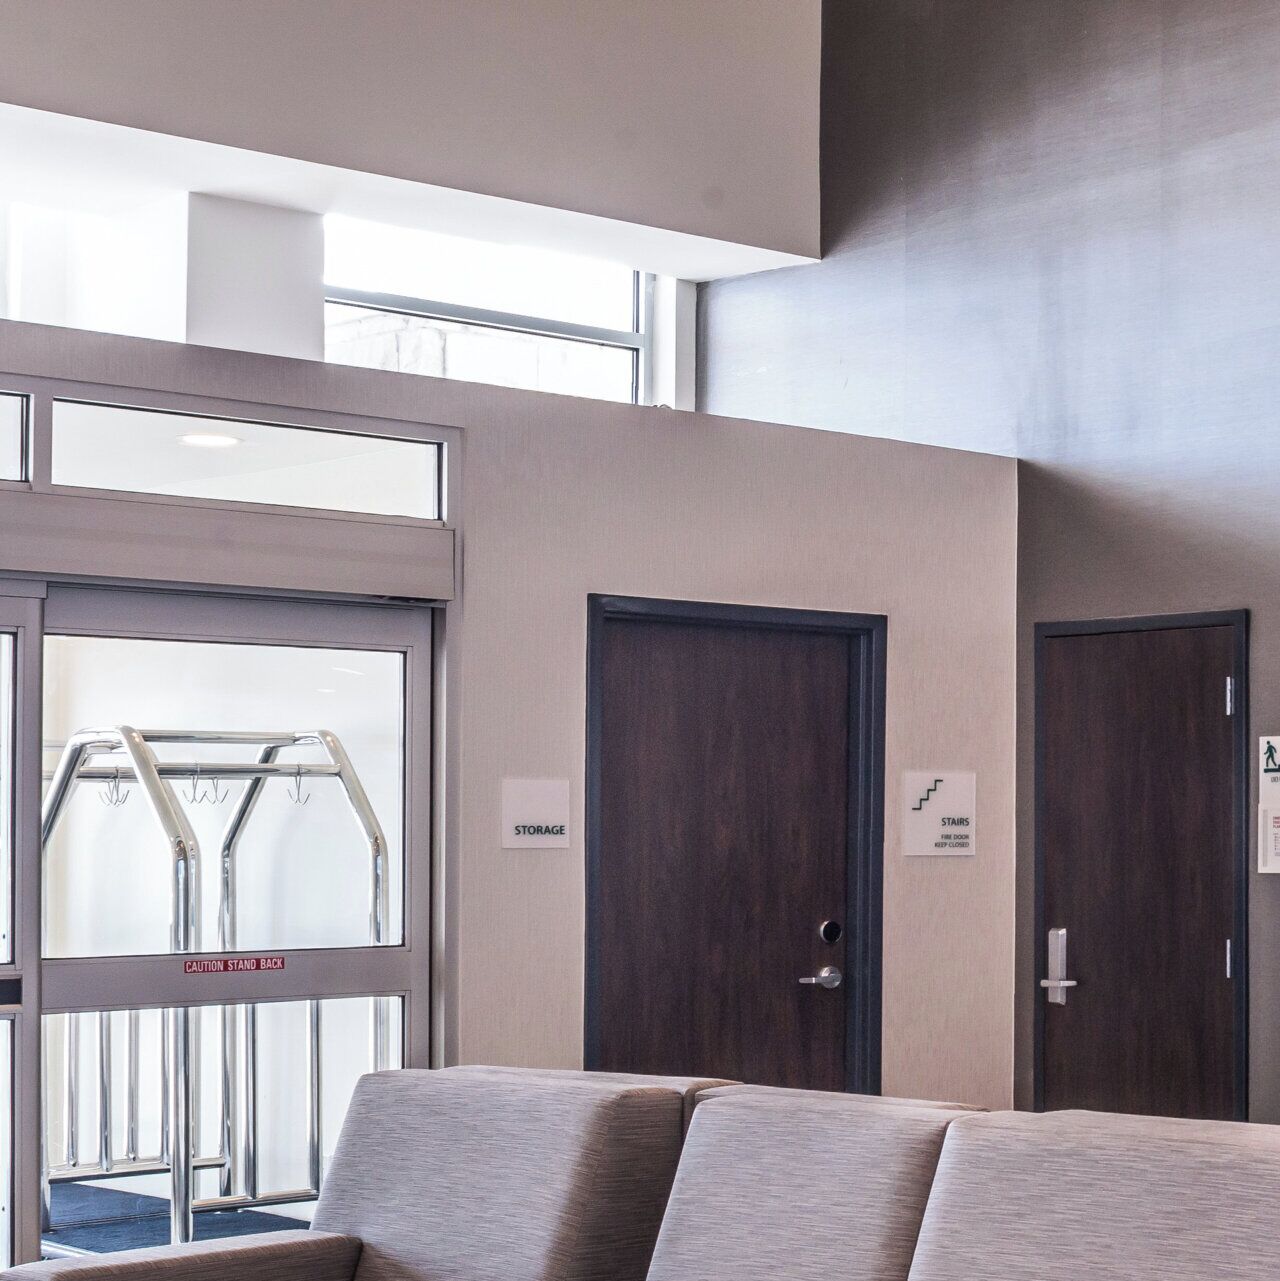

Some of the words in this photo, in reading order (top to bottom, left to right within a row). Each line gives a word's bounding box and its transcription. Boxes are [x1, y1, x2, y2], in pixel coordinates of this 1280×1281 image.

[941, 817, 970, 826] STAIRS
[514, 825, 566, 835] STORAGE
[185, 960, 224, 973] CAUTION
[227, 959, 257, 971] STAND
[260, 958, 283, 969] BACK
